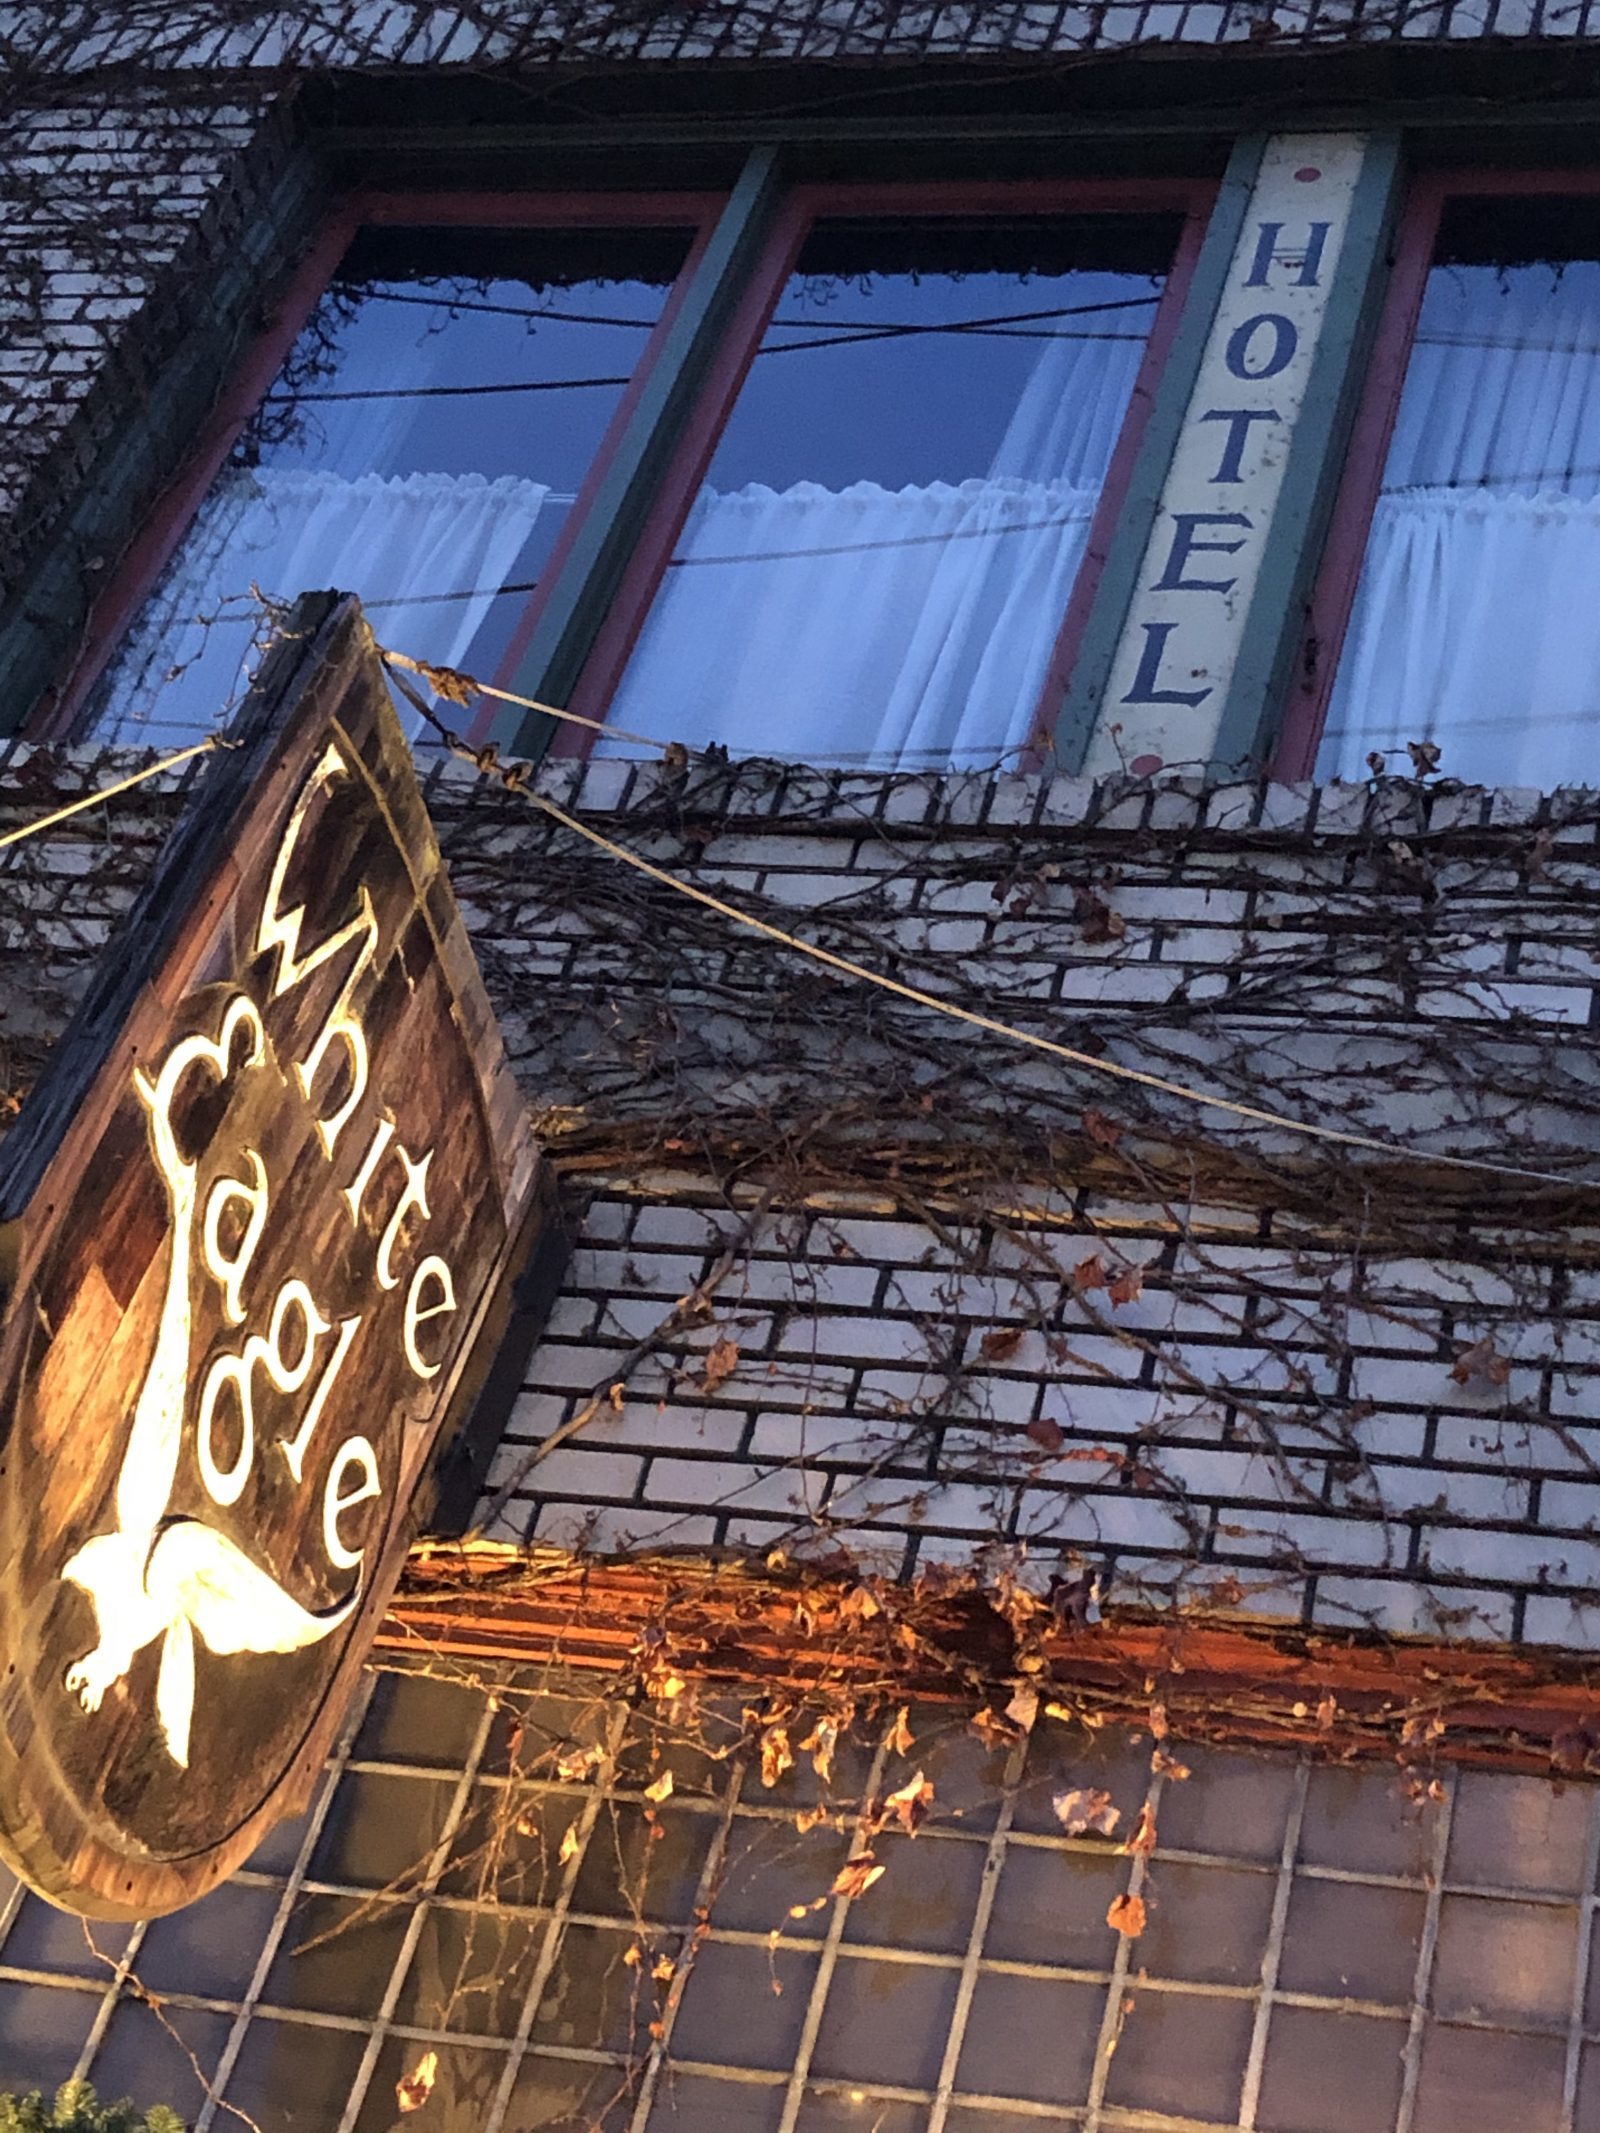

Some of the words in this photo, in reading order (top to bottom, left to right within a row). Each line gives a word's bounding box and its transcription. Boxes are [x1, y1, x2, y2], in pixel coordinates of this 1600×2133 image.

[1119, 222, 1333, 708] HOTEL
[117, 995, 382, 1655] Eagle
[255, 742, 457, 1380] White
